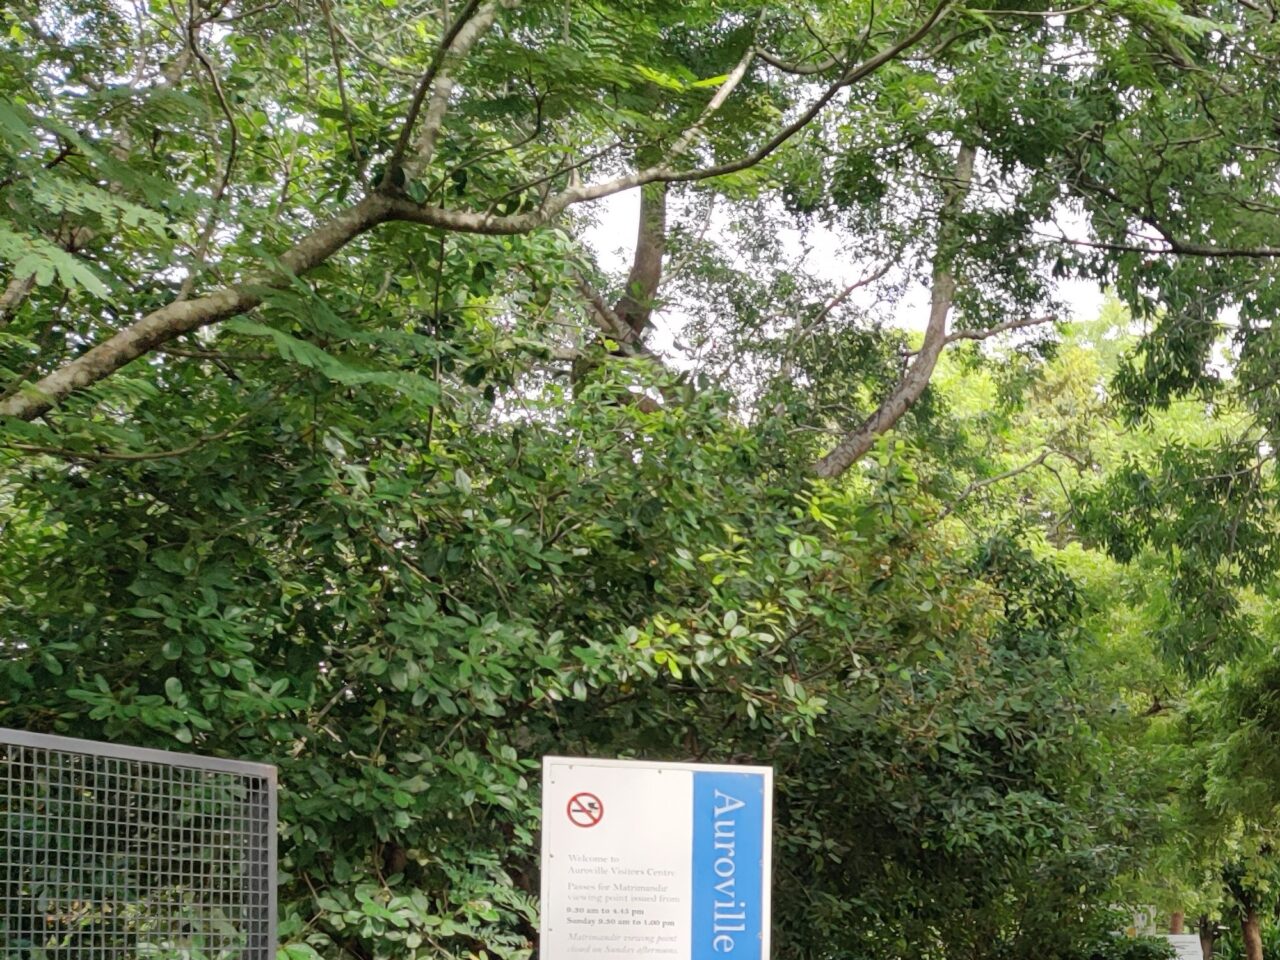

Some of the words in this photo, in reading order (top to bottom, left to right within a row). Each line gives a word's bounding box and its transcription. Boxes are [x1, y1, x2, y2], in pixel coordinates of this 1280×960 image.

[568, 854, 608, 863] Welcome
[610, 855, 620, 863] to
[568, 866, 608, 875] Auroville
[611, 867, 644, 875] Visitors
[646, 867, 676, 877] Centre
[712, 788, 746, 953] Auroville
[568, 882, 595, 891] Passes
[597, 882, 610, 891] for
[632, 909, 645, 917] pm
[566, 917, 595, 927] Sunday
[662, 920, 675, 929] pm
